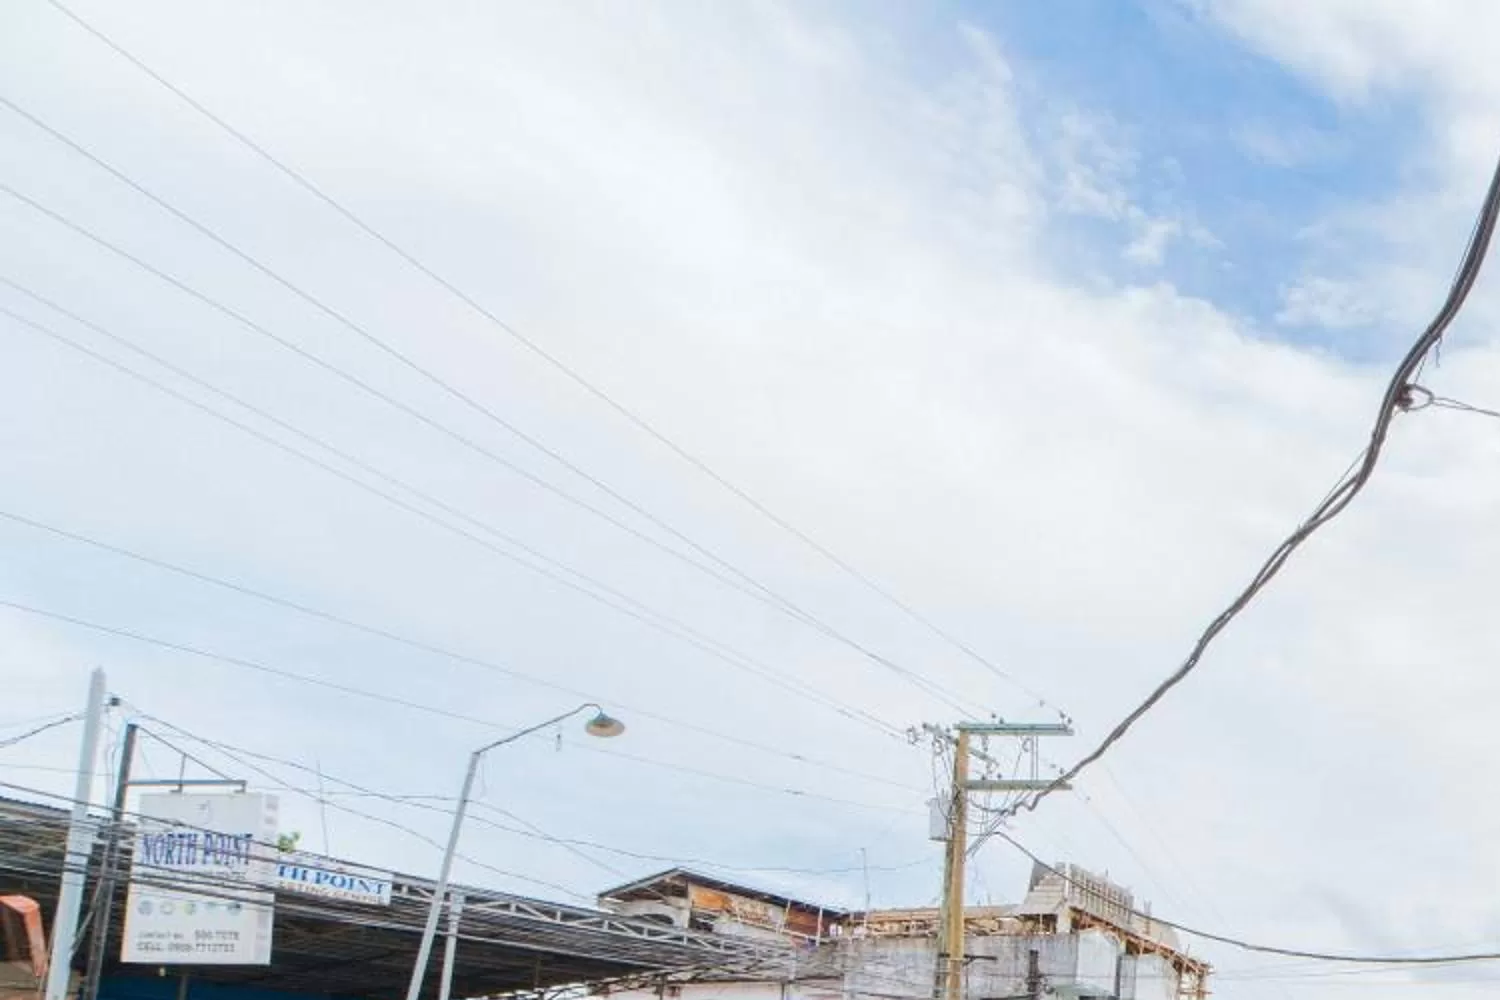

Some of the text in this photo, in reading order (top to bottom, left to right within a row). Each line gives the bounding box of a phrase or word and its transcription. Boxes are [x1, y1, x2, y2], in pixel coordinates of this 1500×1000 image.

[141, 830, 253, 866] NORTH POINT
[313, 871, 384, 895] POINT
